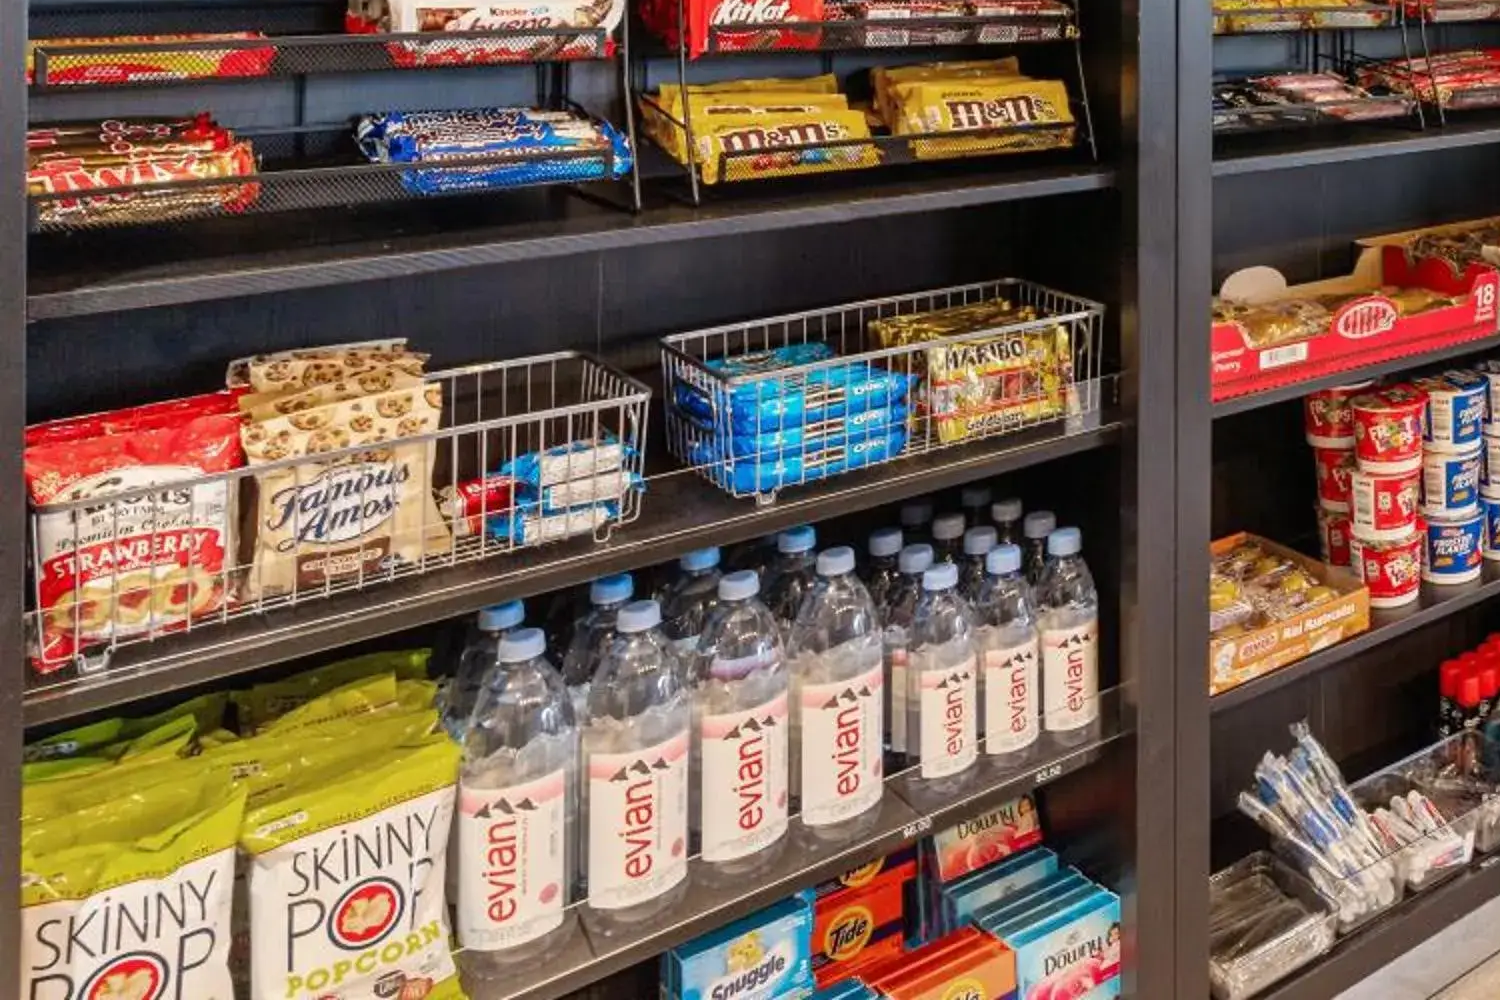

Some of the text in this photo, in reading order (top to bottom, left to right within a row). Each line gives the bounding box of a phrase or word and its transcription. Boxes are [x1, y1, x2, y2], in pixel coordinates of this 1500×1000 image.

[1474, 283, 1495, 307] 18
[945, 340, 1023, 369] HARIBO
[267, 463, 409, 531] Famous
[278, 495, 393, 552] Amos
[52, 532, 207, 579] STRAWBERRY
[1008, 667, 1028, 734] evian
[1064, 648, 1085, 713] evian
[832, 704, 860, 796] evian
[944, 689, 963, 756] evian
[732, 735, 763, 830] evian
[620, 773, 653, 878] evian
[957, 805, 1015, 840] Downy
[482, 818, 517, 923] evian
[286, 919, 441, 998] POPCORN
[829, 917, 868, 956] Tide
[1044, 935, 1104, 977] Downy
[711, 954, 786, 1000] Snuggle
